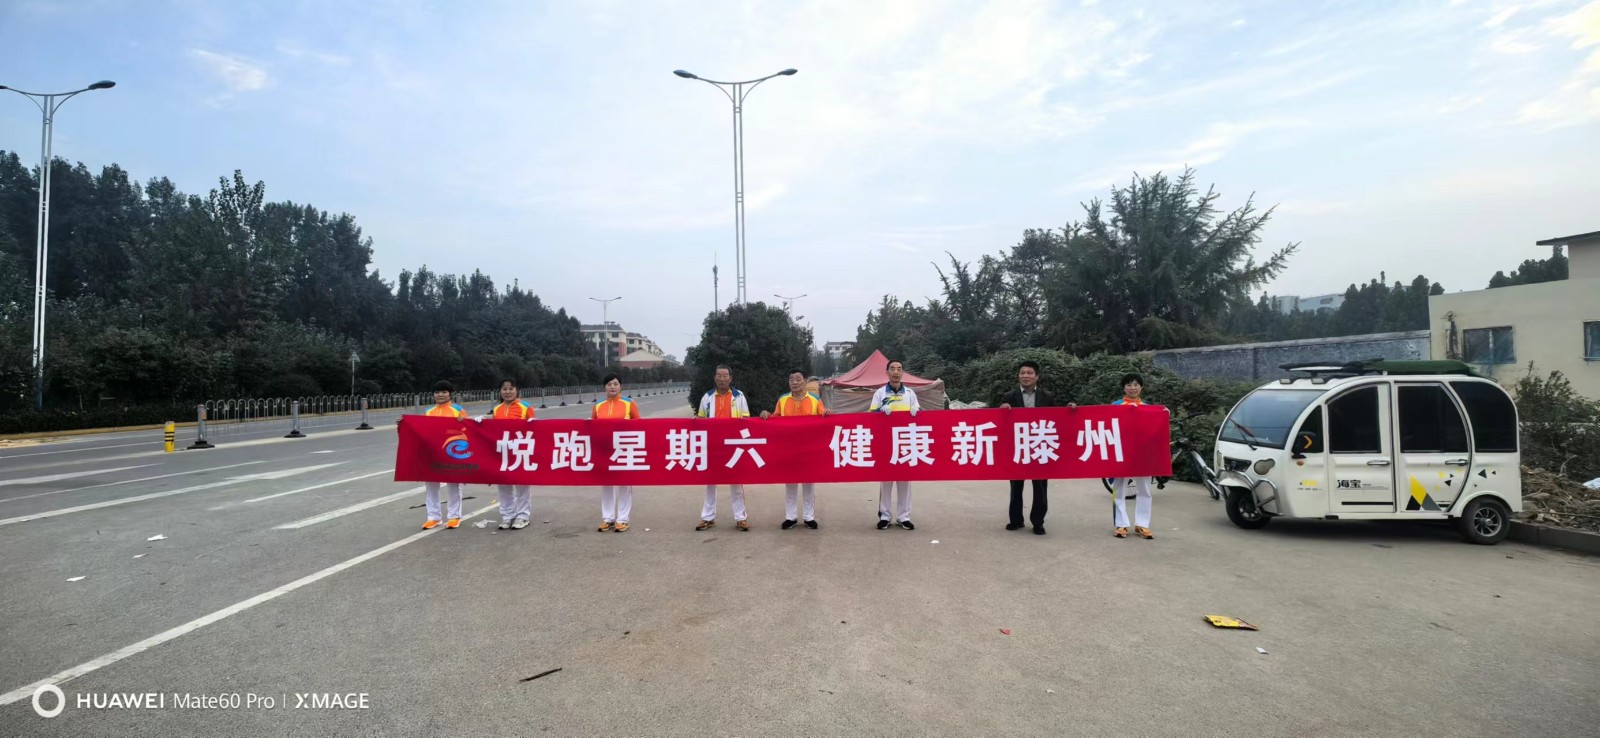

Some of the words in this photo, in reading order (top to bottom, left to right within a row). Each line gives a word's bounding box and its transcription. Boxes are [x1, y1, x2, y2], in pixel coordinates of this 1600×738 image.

[496, 428, 767, 471] 悦跑星期六
[829, 418, 1124, 468] 健康新滕州
[1336, 479, 1361, 489] 海宝
